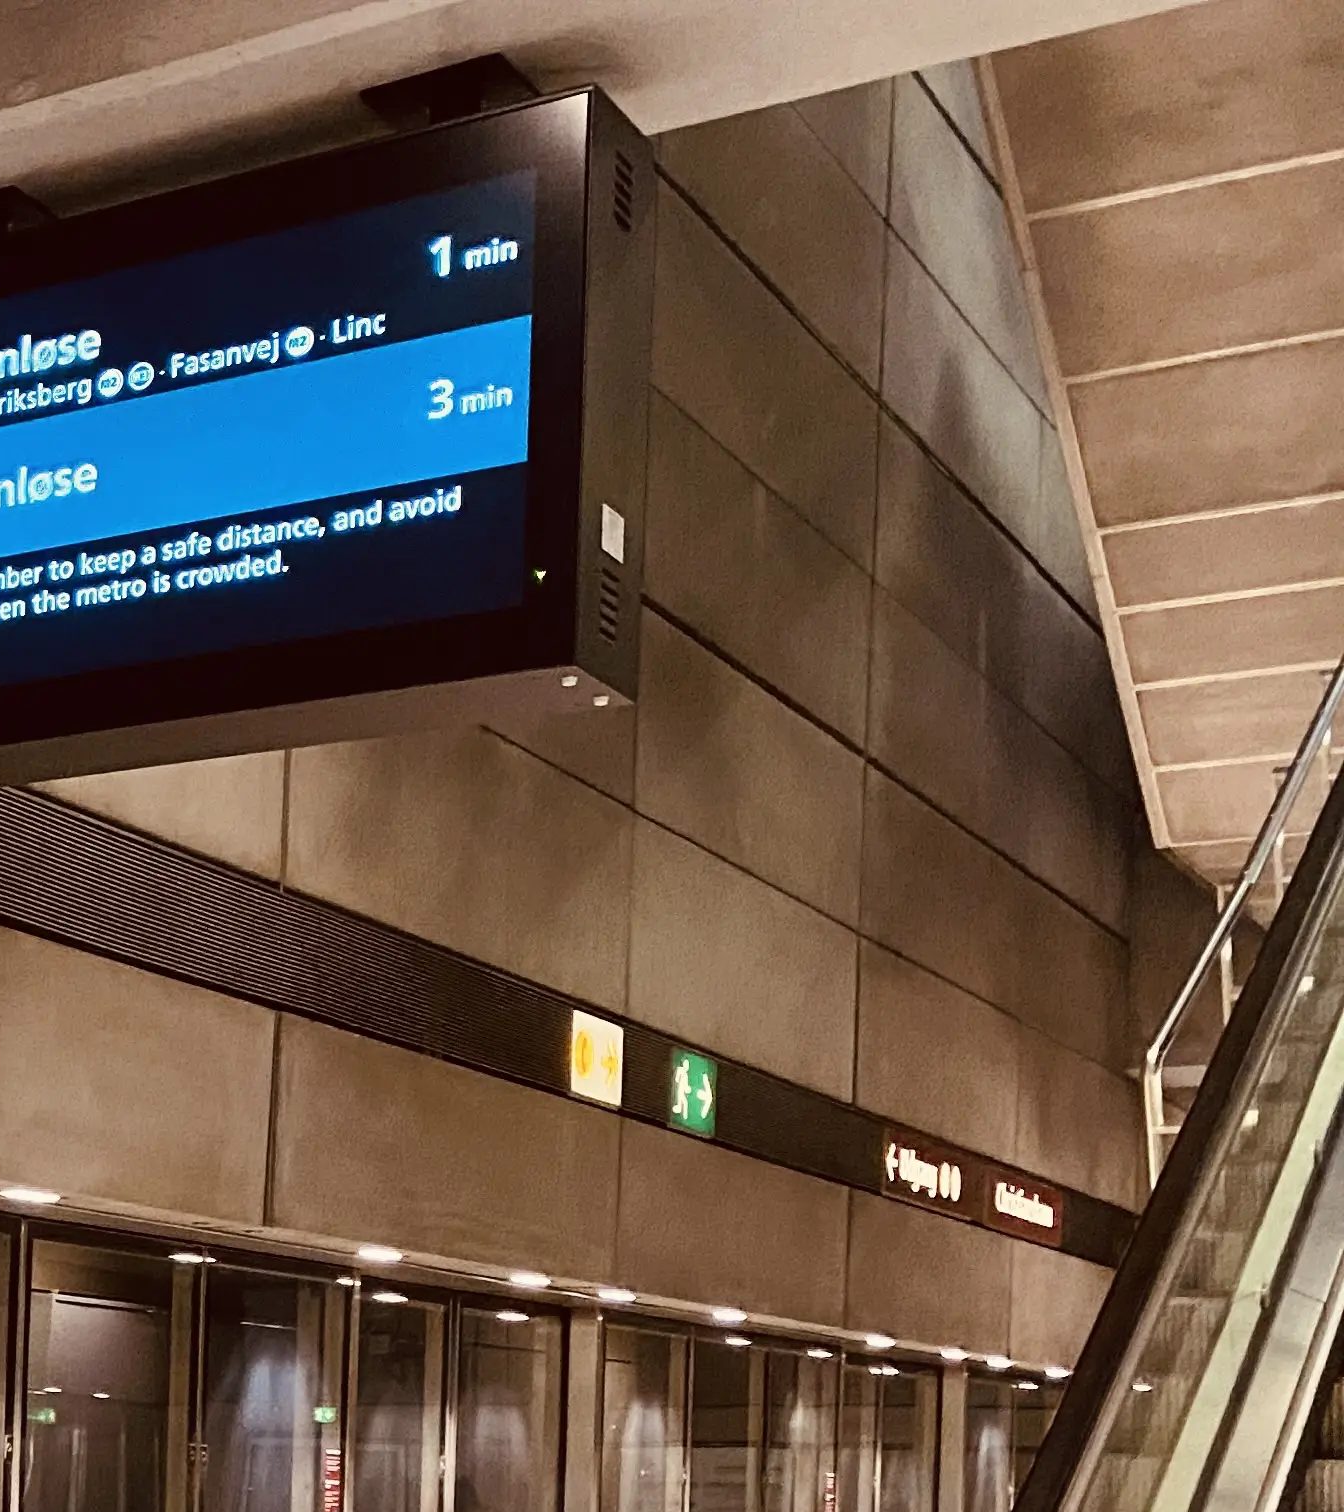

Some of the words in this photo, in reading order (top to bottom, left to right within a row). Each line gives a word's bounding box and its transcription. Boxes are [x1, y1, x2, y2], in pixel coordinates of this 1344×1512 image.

[429, 235, 452, 277] 1
[464, 237, 518, 270] min
[170, 332, 280, 378] Fasanvej
[427, 378, 454, 420] 3
[460, 384, 513, 415] min
[49, 560, 74, 581] to
[79, 549, 136, 576] keep
[140, 546, 156, 563] a
[162, 532, 212, 562] safe
[216, 515, 326, 552] distance,
[333, 500, 384, 532] and
[388, 485, 462, 522] avoid
[31, 590, 70, 615] the
[76, 578, 147, 607] metro
[152, 571, 171, 594] is
[175, 550, 290, 591] crowded.
